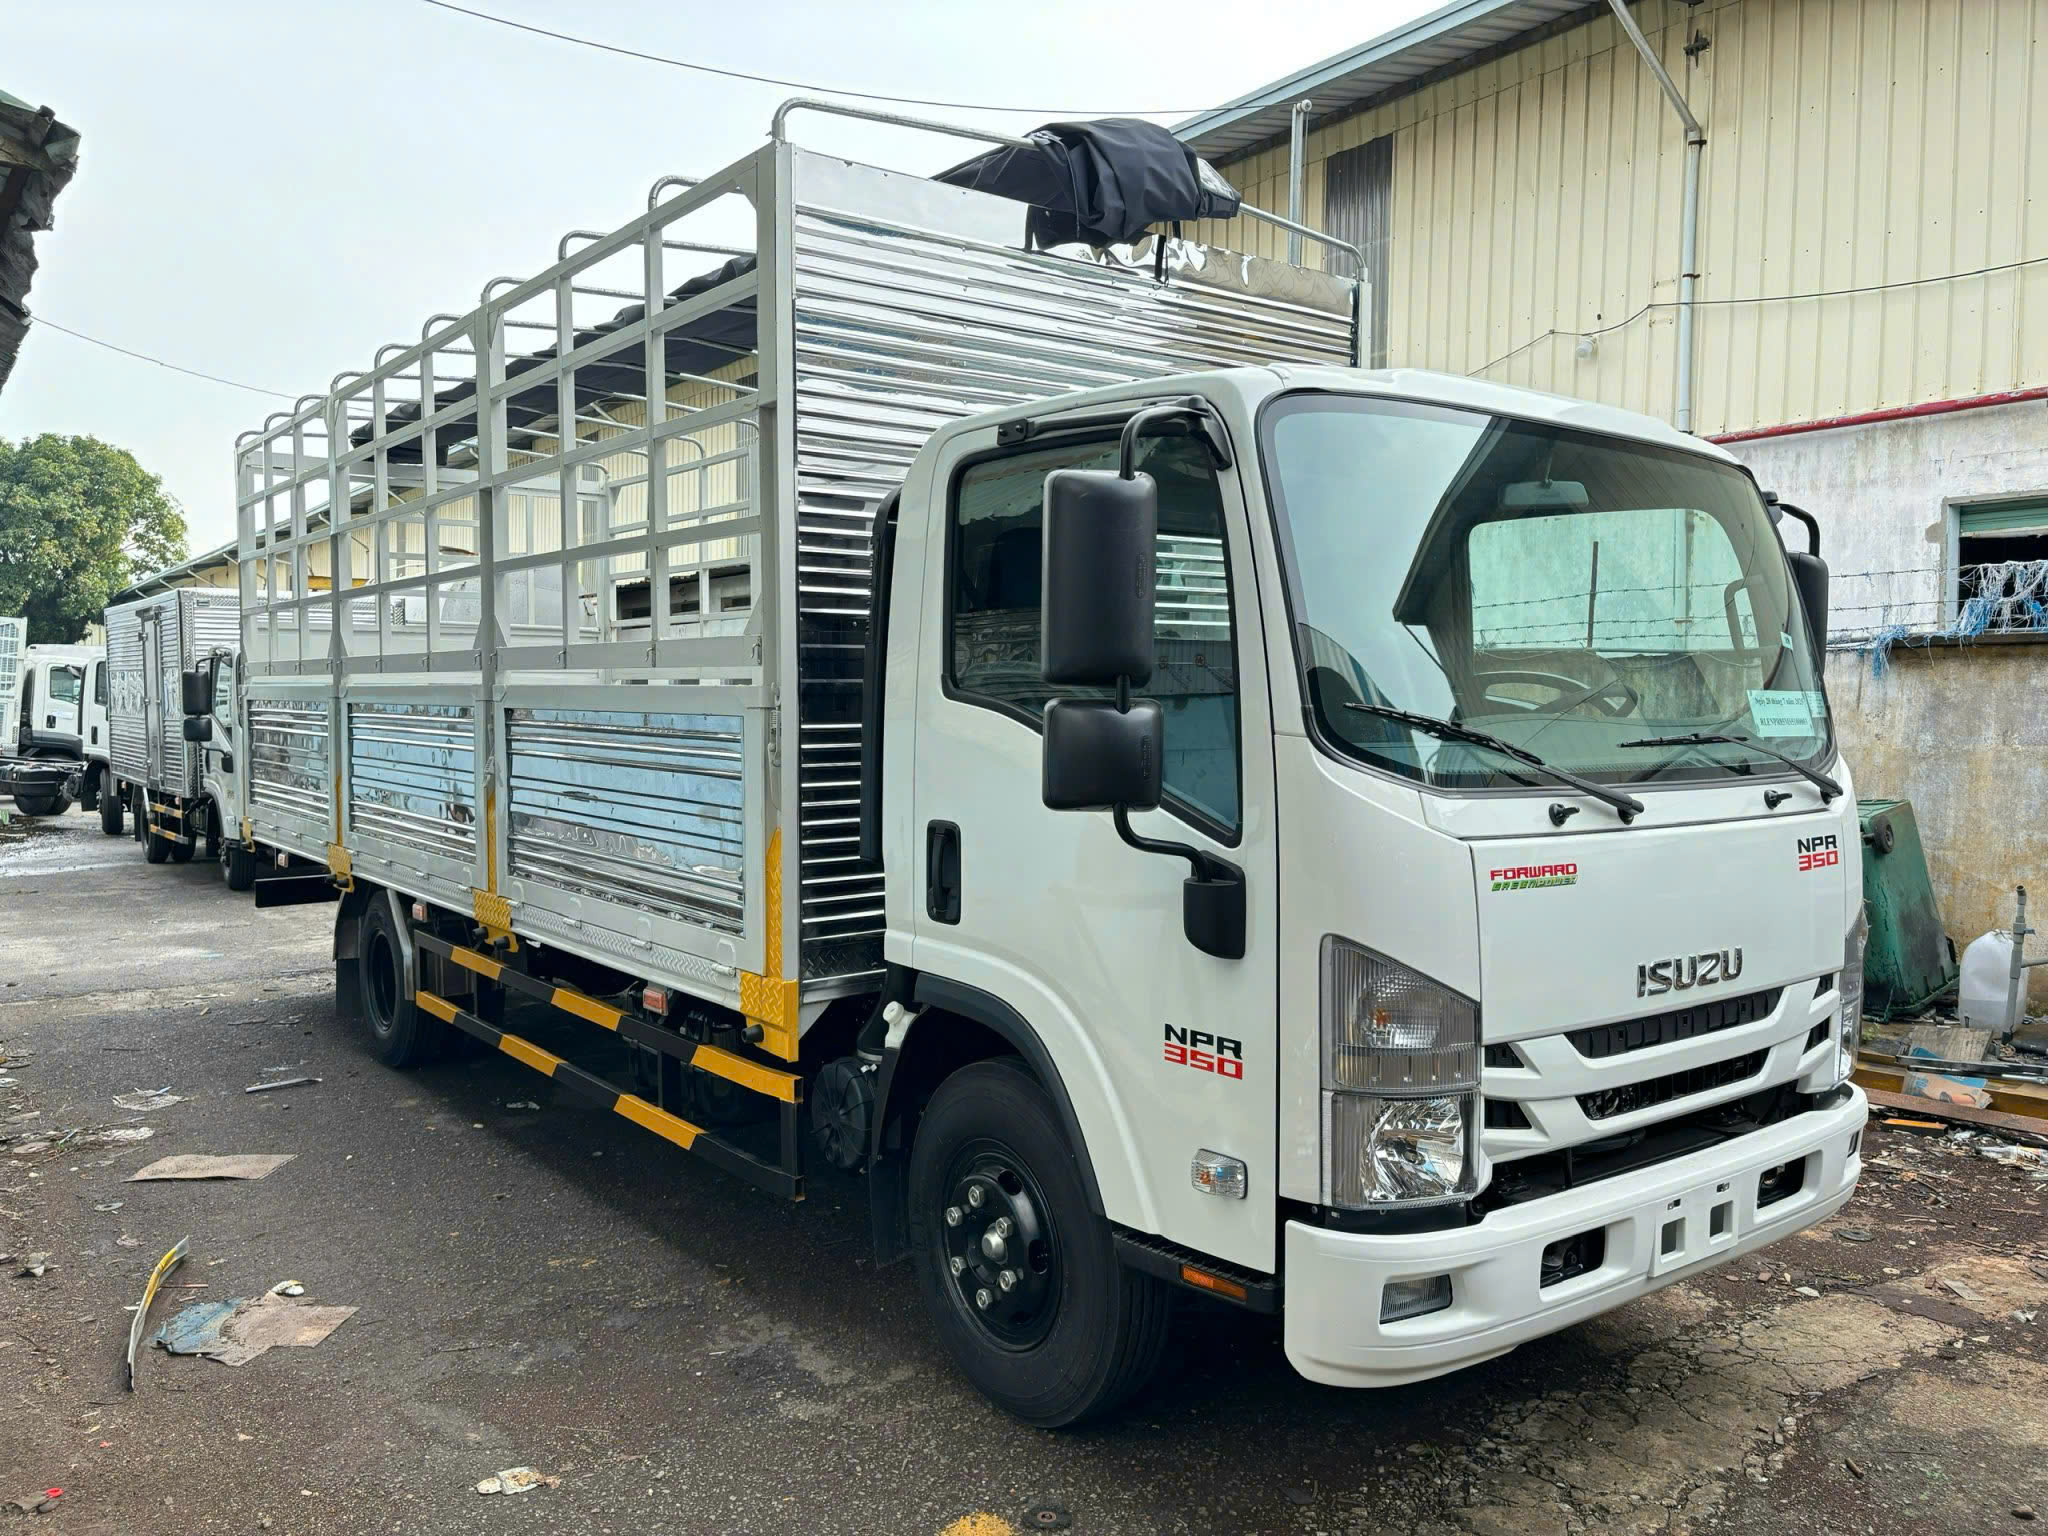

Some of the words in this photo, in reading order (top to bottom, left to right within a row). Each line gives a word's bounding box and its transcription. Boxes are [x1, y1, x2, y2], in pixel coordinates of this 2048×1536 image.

[1797, 834, 1838, 854] NPR
[1490, 863, 1578, 881] FORWARD
[1798, 850, 1839, 872] 350
[1636, 945, 1743, 999] ISUZU
[1164, 1023, 1243, 1060] NPR
[1164, 1042, 1243, 1081] 350
